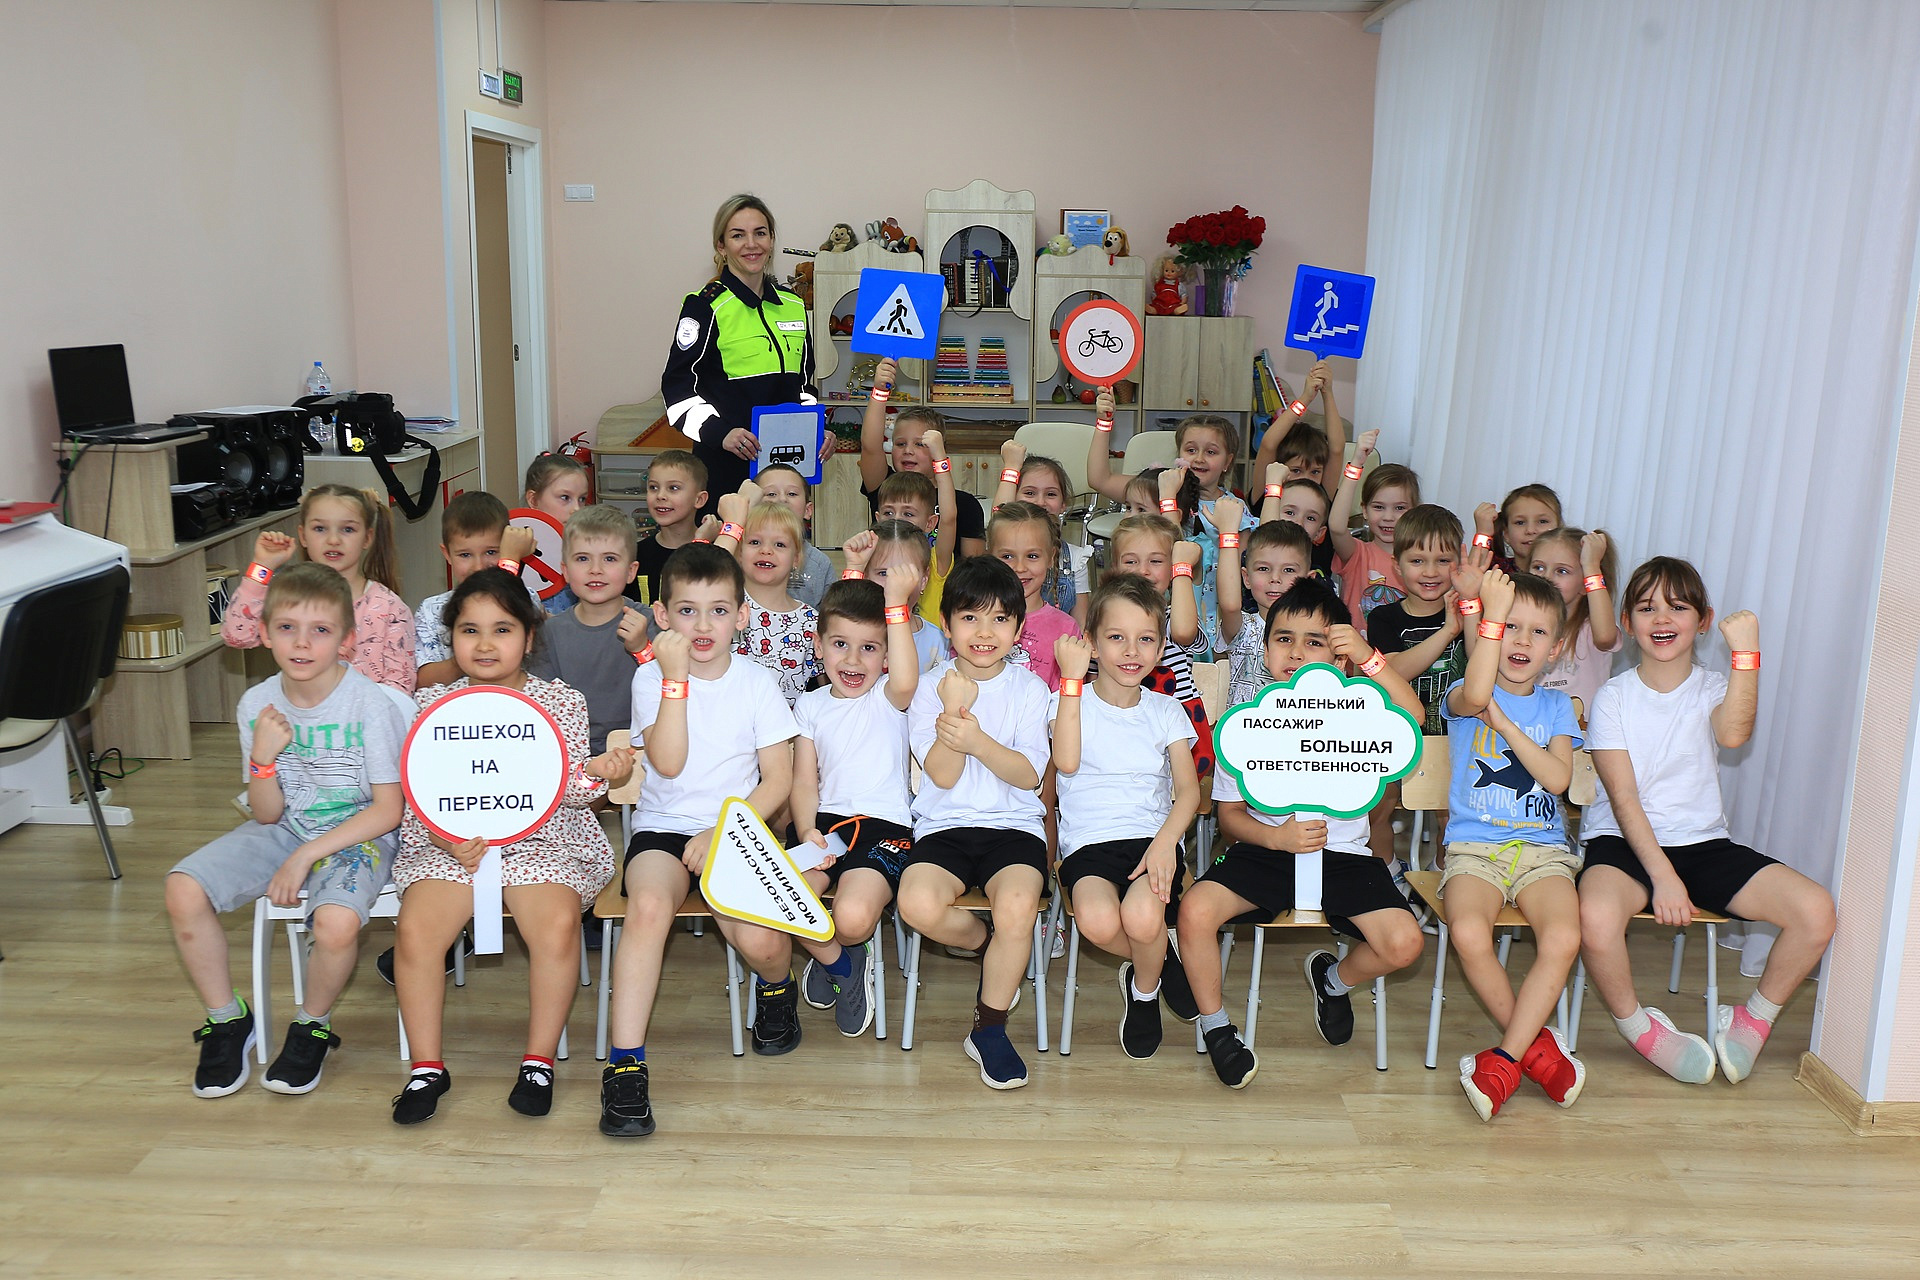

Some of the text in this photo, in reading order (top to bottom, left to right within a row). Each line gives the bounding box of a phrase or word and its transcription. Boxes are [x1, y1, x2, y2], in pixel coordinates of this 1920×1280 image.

[1276, 697, 1365, 710] МАЛЕНЬКИЙ
[434, 724, 536, 741] ПЕШЕХОД
[1243, 718, 1324, 730] ПАССАЖИР
[1300, 739, 1393, 754] БОЛЬШАЯ
[1471, 726, 1502, 759] ALL
[471, 759, 500, 774] НА
[1246, 760, 1390, 773] ОТВЕТСТВЕННОСТЬ
[439, 794, 534, 812] ПЕРЕХОД
[1469, 789, 1556, 822] HAVING FUN
[727, 830, 797, 922] БЕЗОПАСНАЯ
[736, 812, 818, 925] МОБИЛЬНОСТЬ
